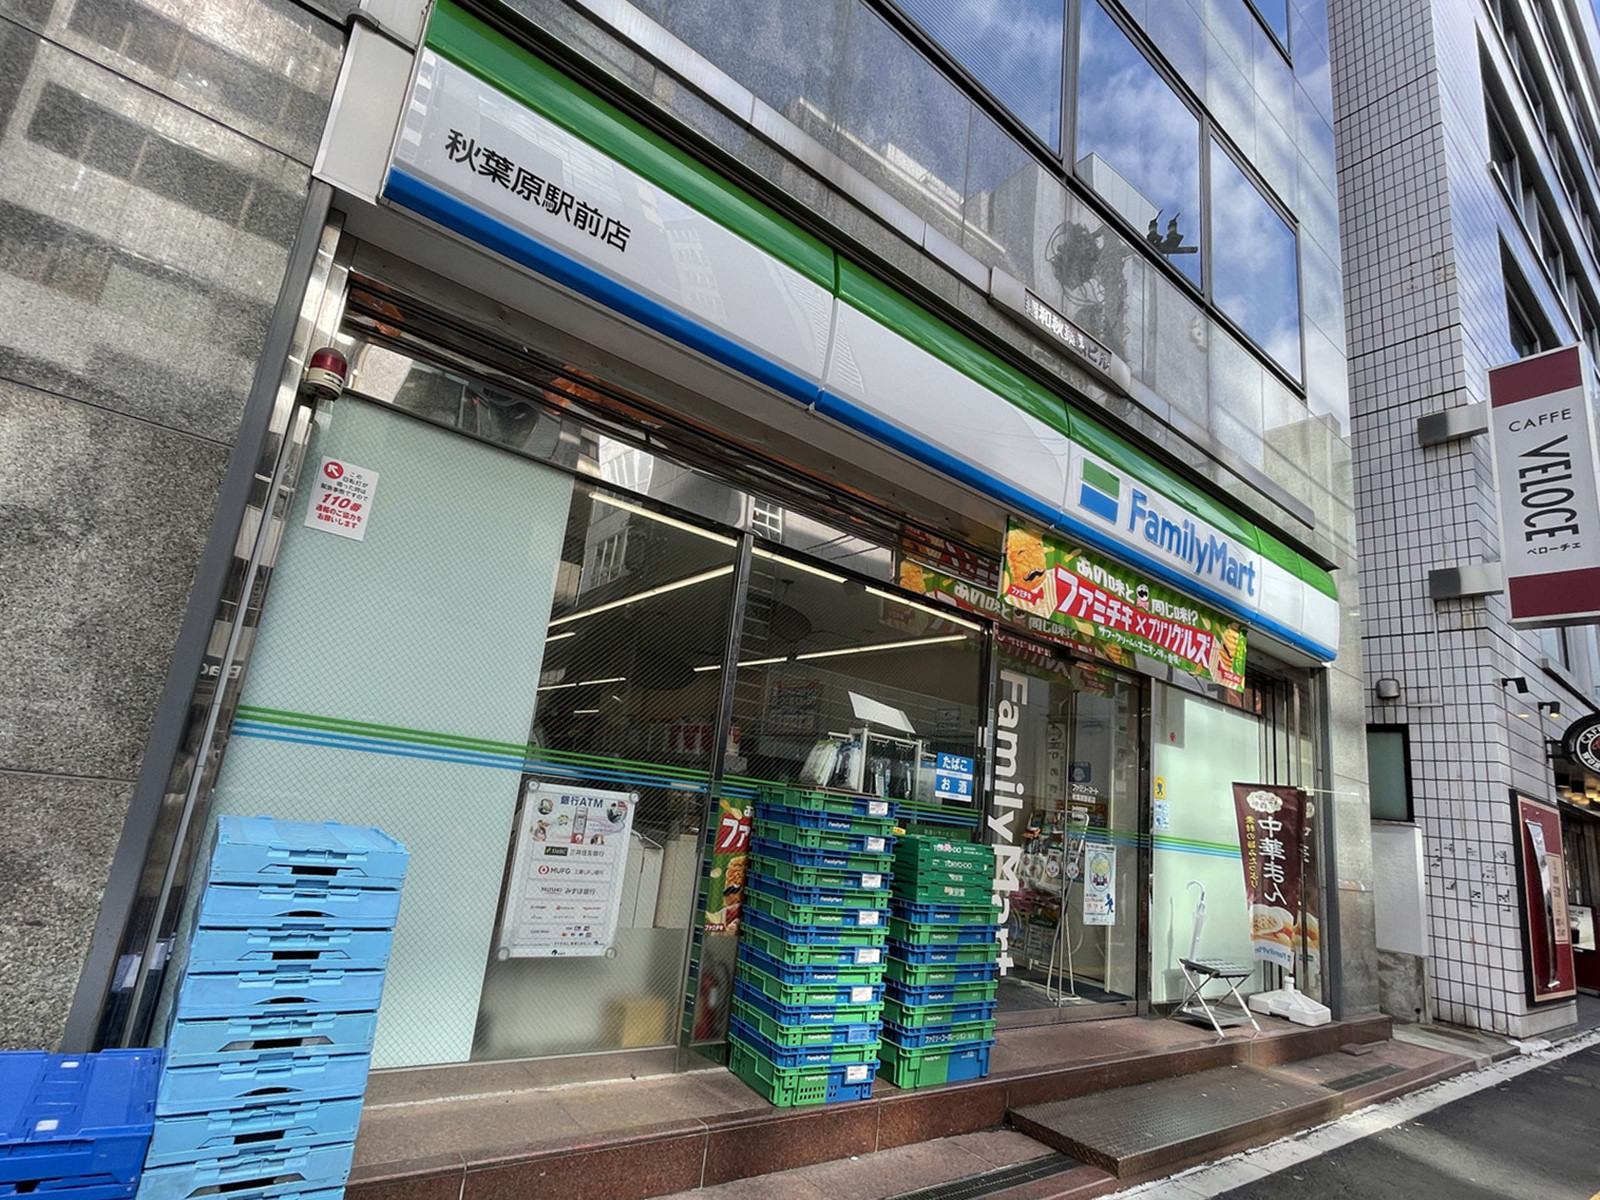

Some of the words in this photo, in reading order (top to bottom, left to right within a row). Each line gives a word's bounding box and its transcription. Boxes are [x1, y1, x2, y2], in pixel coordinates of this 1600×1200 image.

[445, 128, 631, 252] 秋葉原駅前店
[1508, 408, 1572, 433] CAFFE
[322, 493, 362, 512] 110番
[1518, 434, 1580, 542] VELOCE
[1127, 487, 1256, 597] FamilyMart
[1076, 555, 1136, 605] あの味と
[941, 777, 968, 794] お酒
[942, 755, 968, 772] たばこ
[987, 669, 1029, 977] FamilyMart
